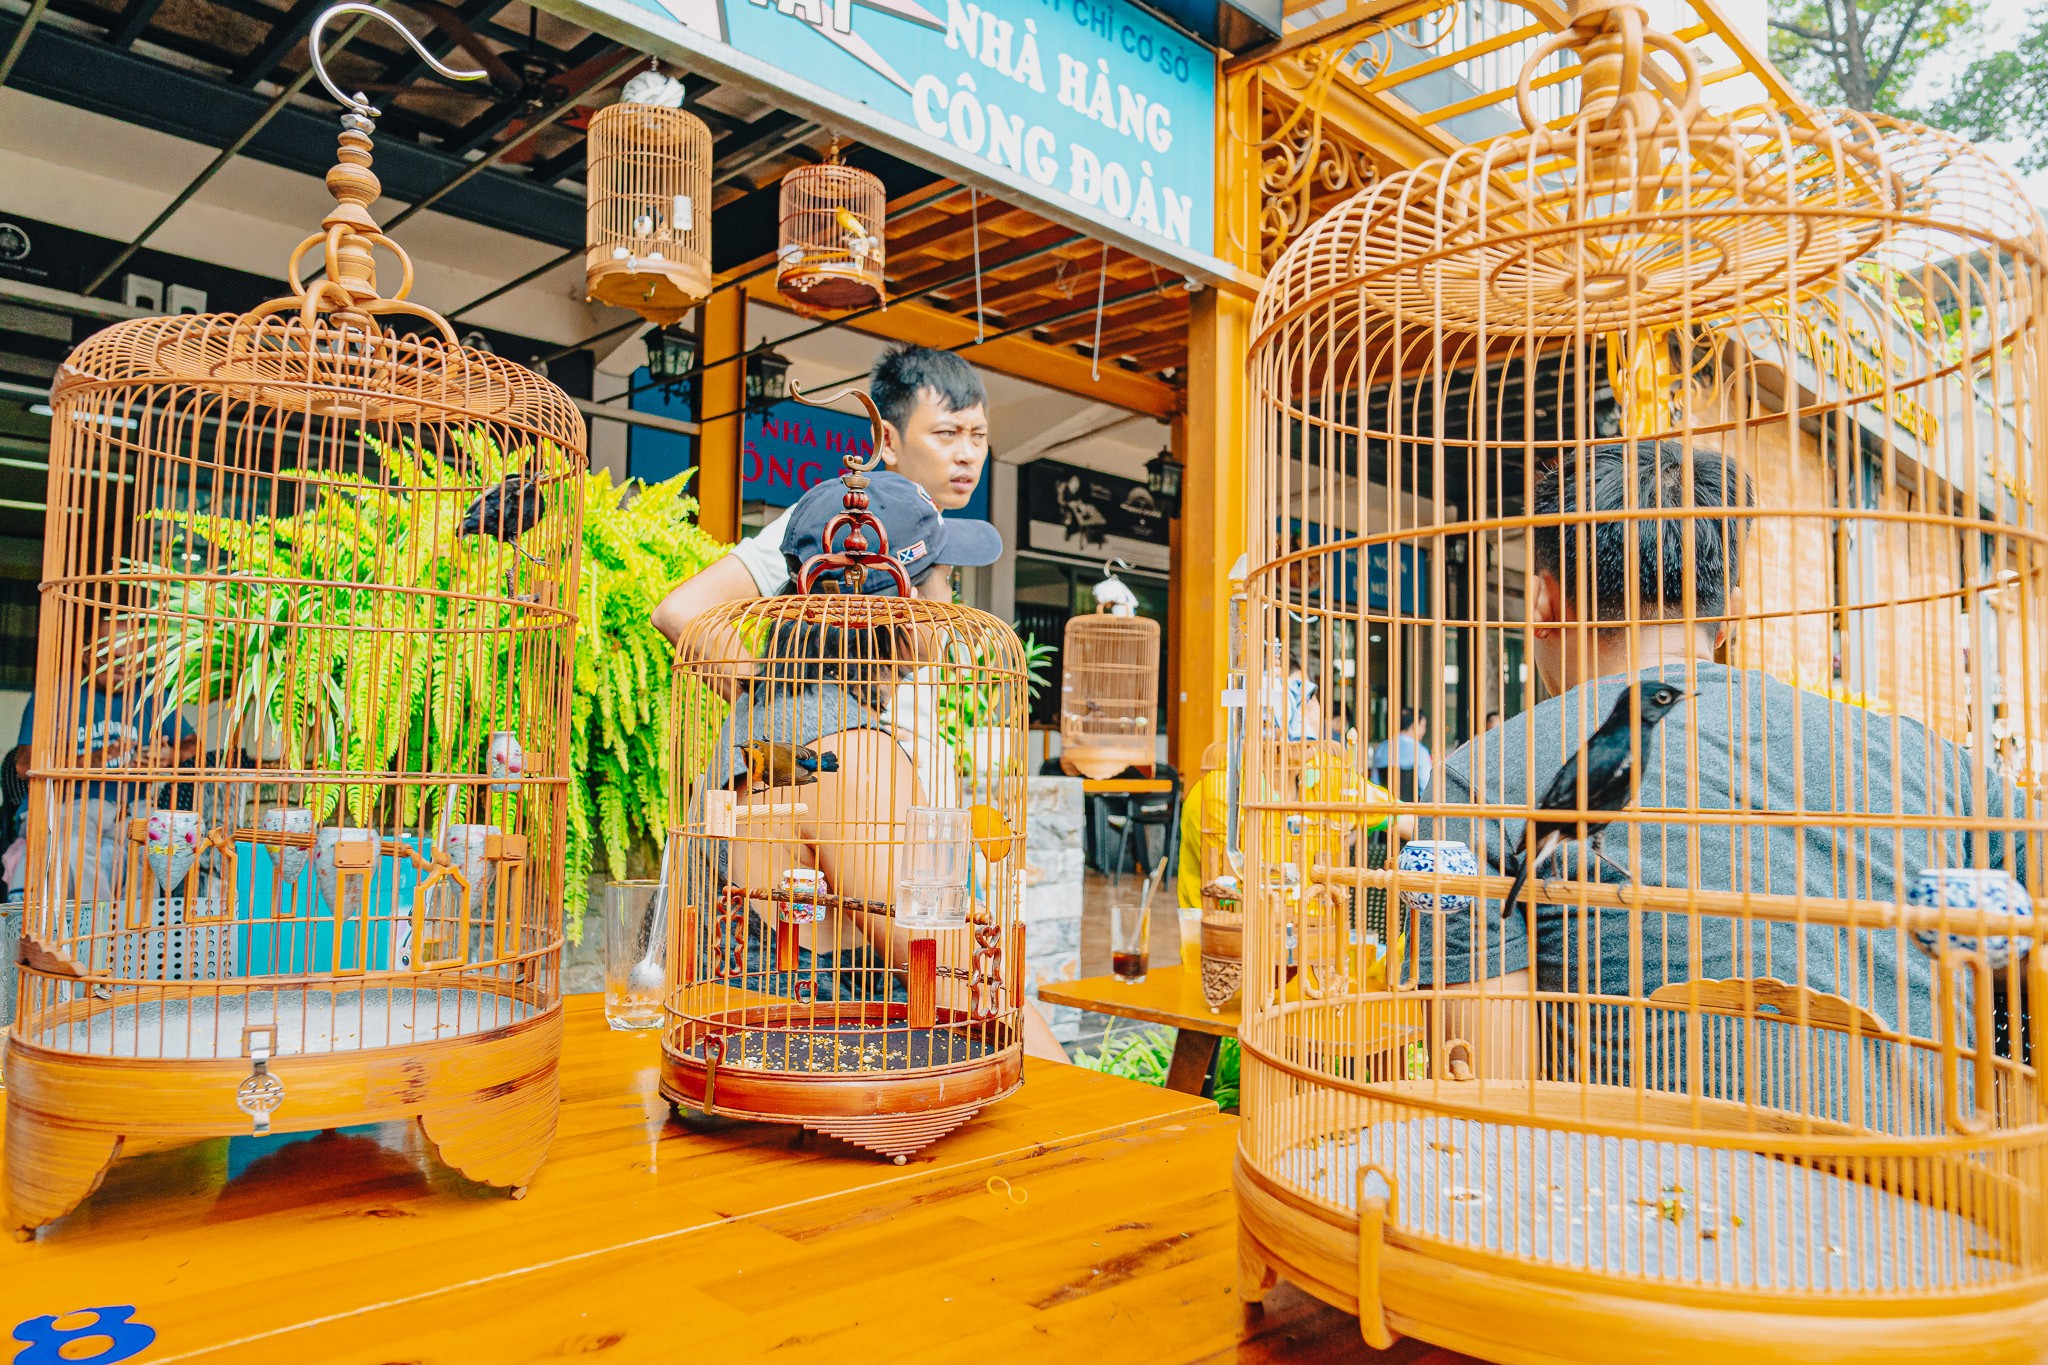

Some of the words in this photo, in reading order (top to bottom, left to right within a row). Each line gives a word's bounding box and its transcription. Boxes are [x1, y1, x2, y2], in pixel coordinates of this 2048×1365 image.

[945, 0, 1046, 94] NHÀ
[1056, 53, 1173, 154] HÀNG
[1120, 25, 1154, 63] CƠ
[1159, 46, 1190, 83] SỞ
[912, 72, 1059, 186] CÔNG
[1068, 143, 1193, 247] ĐOÀN
[743, 441, 823, 492] ÔNG
[762, 419, 817, 447] NHÀ
[826, 428, 875, 457] HÀN
